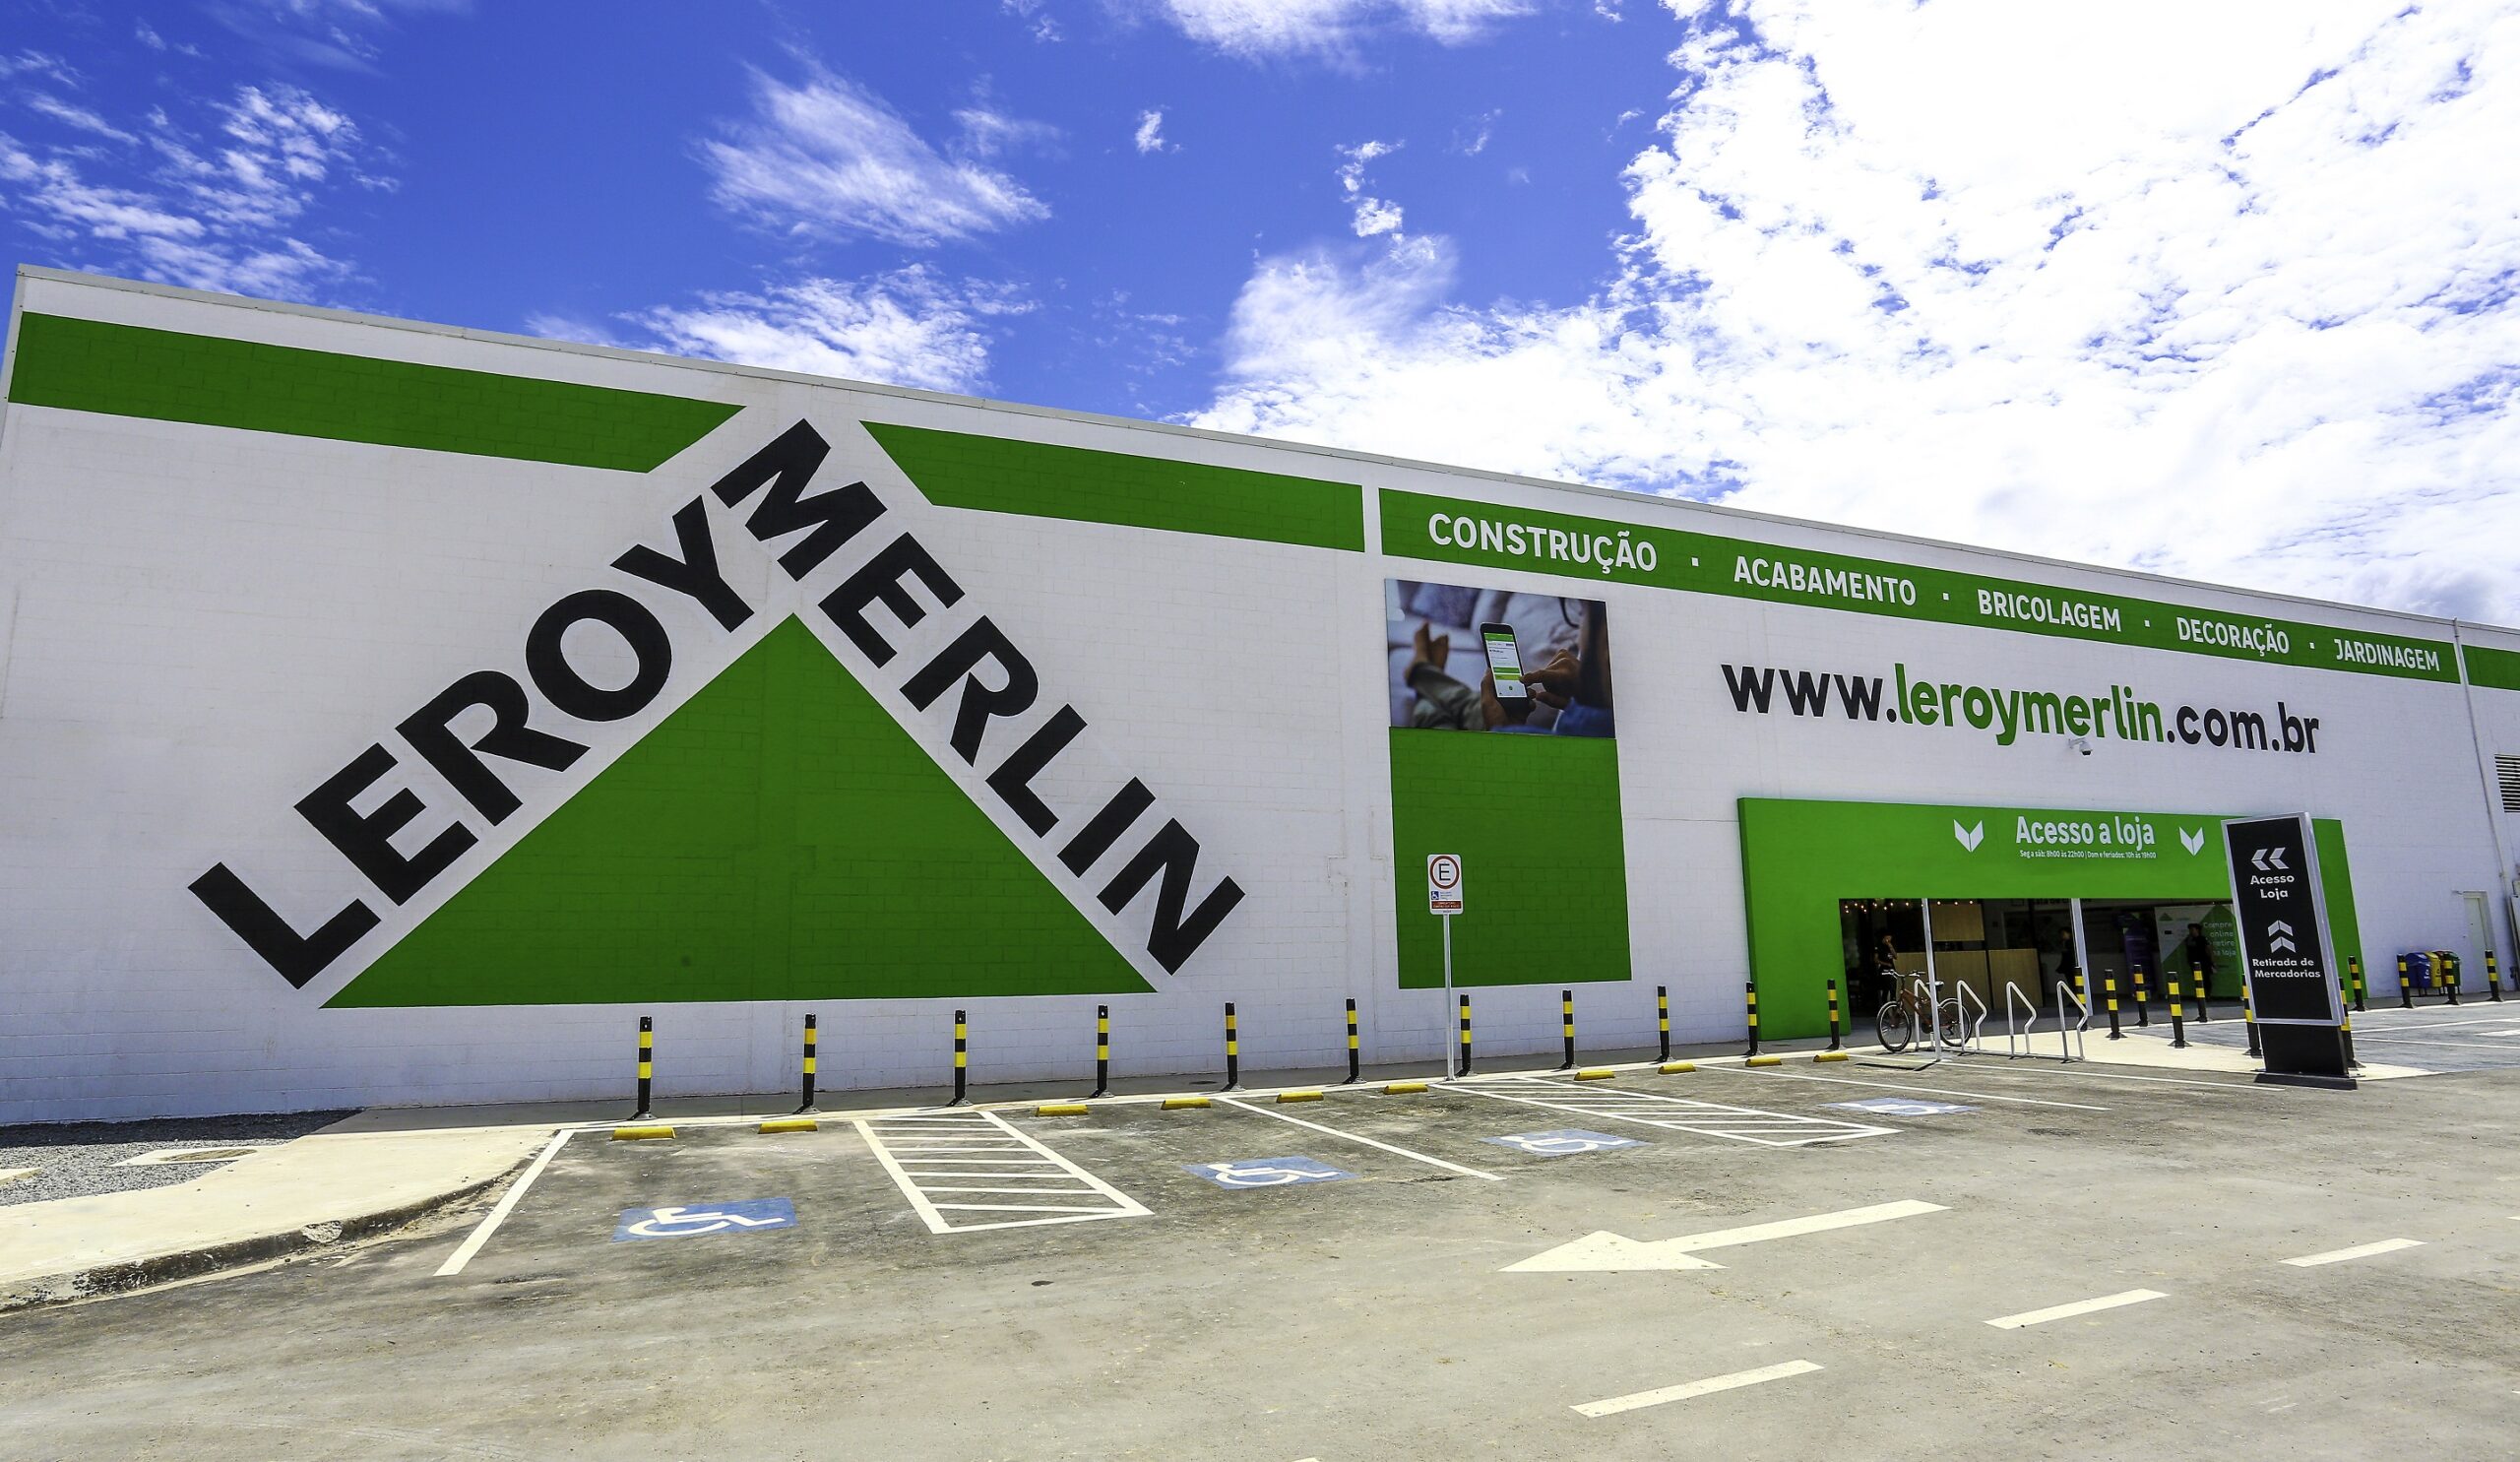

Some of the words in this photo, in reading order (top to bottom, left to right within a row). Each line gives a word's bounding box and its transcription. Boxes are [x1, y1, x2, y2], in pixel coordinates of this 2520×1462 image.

[1428, 513, 1657, 575] CONSTRUÇÃO
[1733, 555, 1917, 606] ACABAMENTO
[1977, 589, 2121, 632] BRICOLAGEM
[2175, 616, 2290, 657] DECORAÇÃO
[2333, 638, 2440, 671] JARDINAGEM
[711, 418, 1245, 976] MERLIN
[1721, 663, 2319, 754] www.leroymerlin.com.br
[188, 495, 754, 989] LEROY
[2015, 815, 2094, 845] Acesso
[2099, 822, 2112, 845] a
[2114, 815, 2156, 852] loja
[2020, 850, 2030, 858] Seg
[1439, 863, 1451, 881] E
[2249, 874, 2295, 885] Acesso
[2260, 888, 2289, 900] Loja
[2251, 958, 2298, 967] Retirada
[2300, 958, 2314, 967] de
[2254, 969, 2321, 979] Mercadorias
